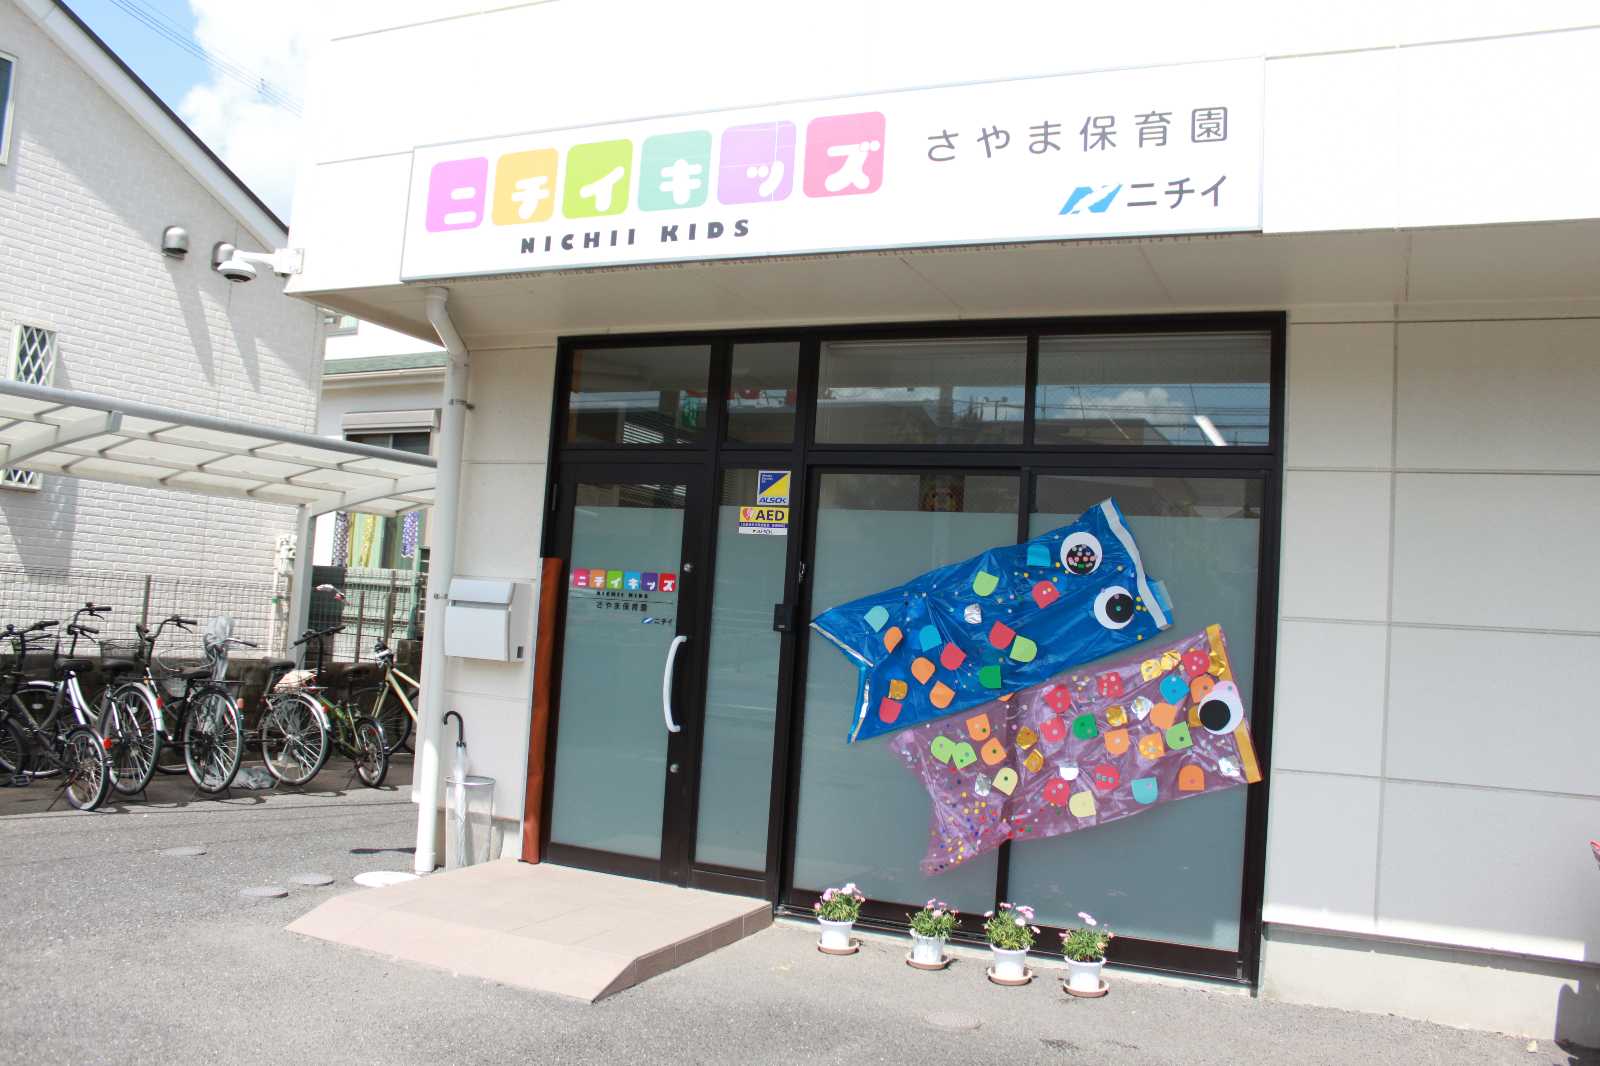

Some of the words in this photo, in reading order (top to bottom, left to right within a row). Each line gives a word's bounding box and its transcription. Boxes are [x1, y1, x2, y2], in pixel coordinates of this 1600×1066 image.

[927, 106, 1228, 162] さやま保育園
[443, 138, 881, 225] ニチイキッズ
[1127, 175, 1227, 209] ニチイ
[521, 228, 636, 254] NICHII
[660, 219, 750, 243] KIDS
[755, 509, 785, 521] AED
[576, 574, 675, 592] ニチイキッズ
